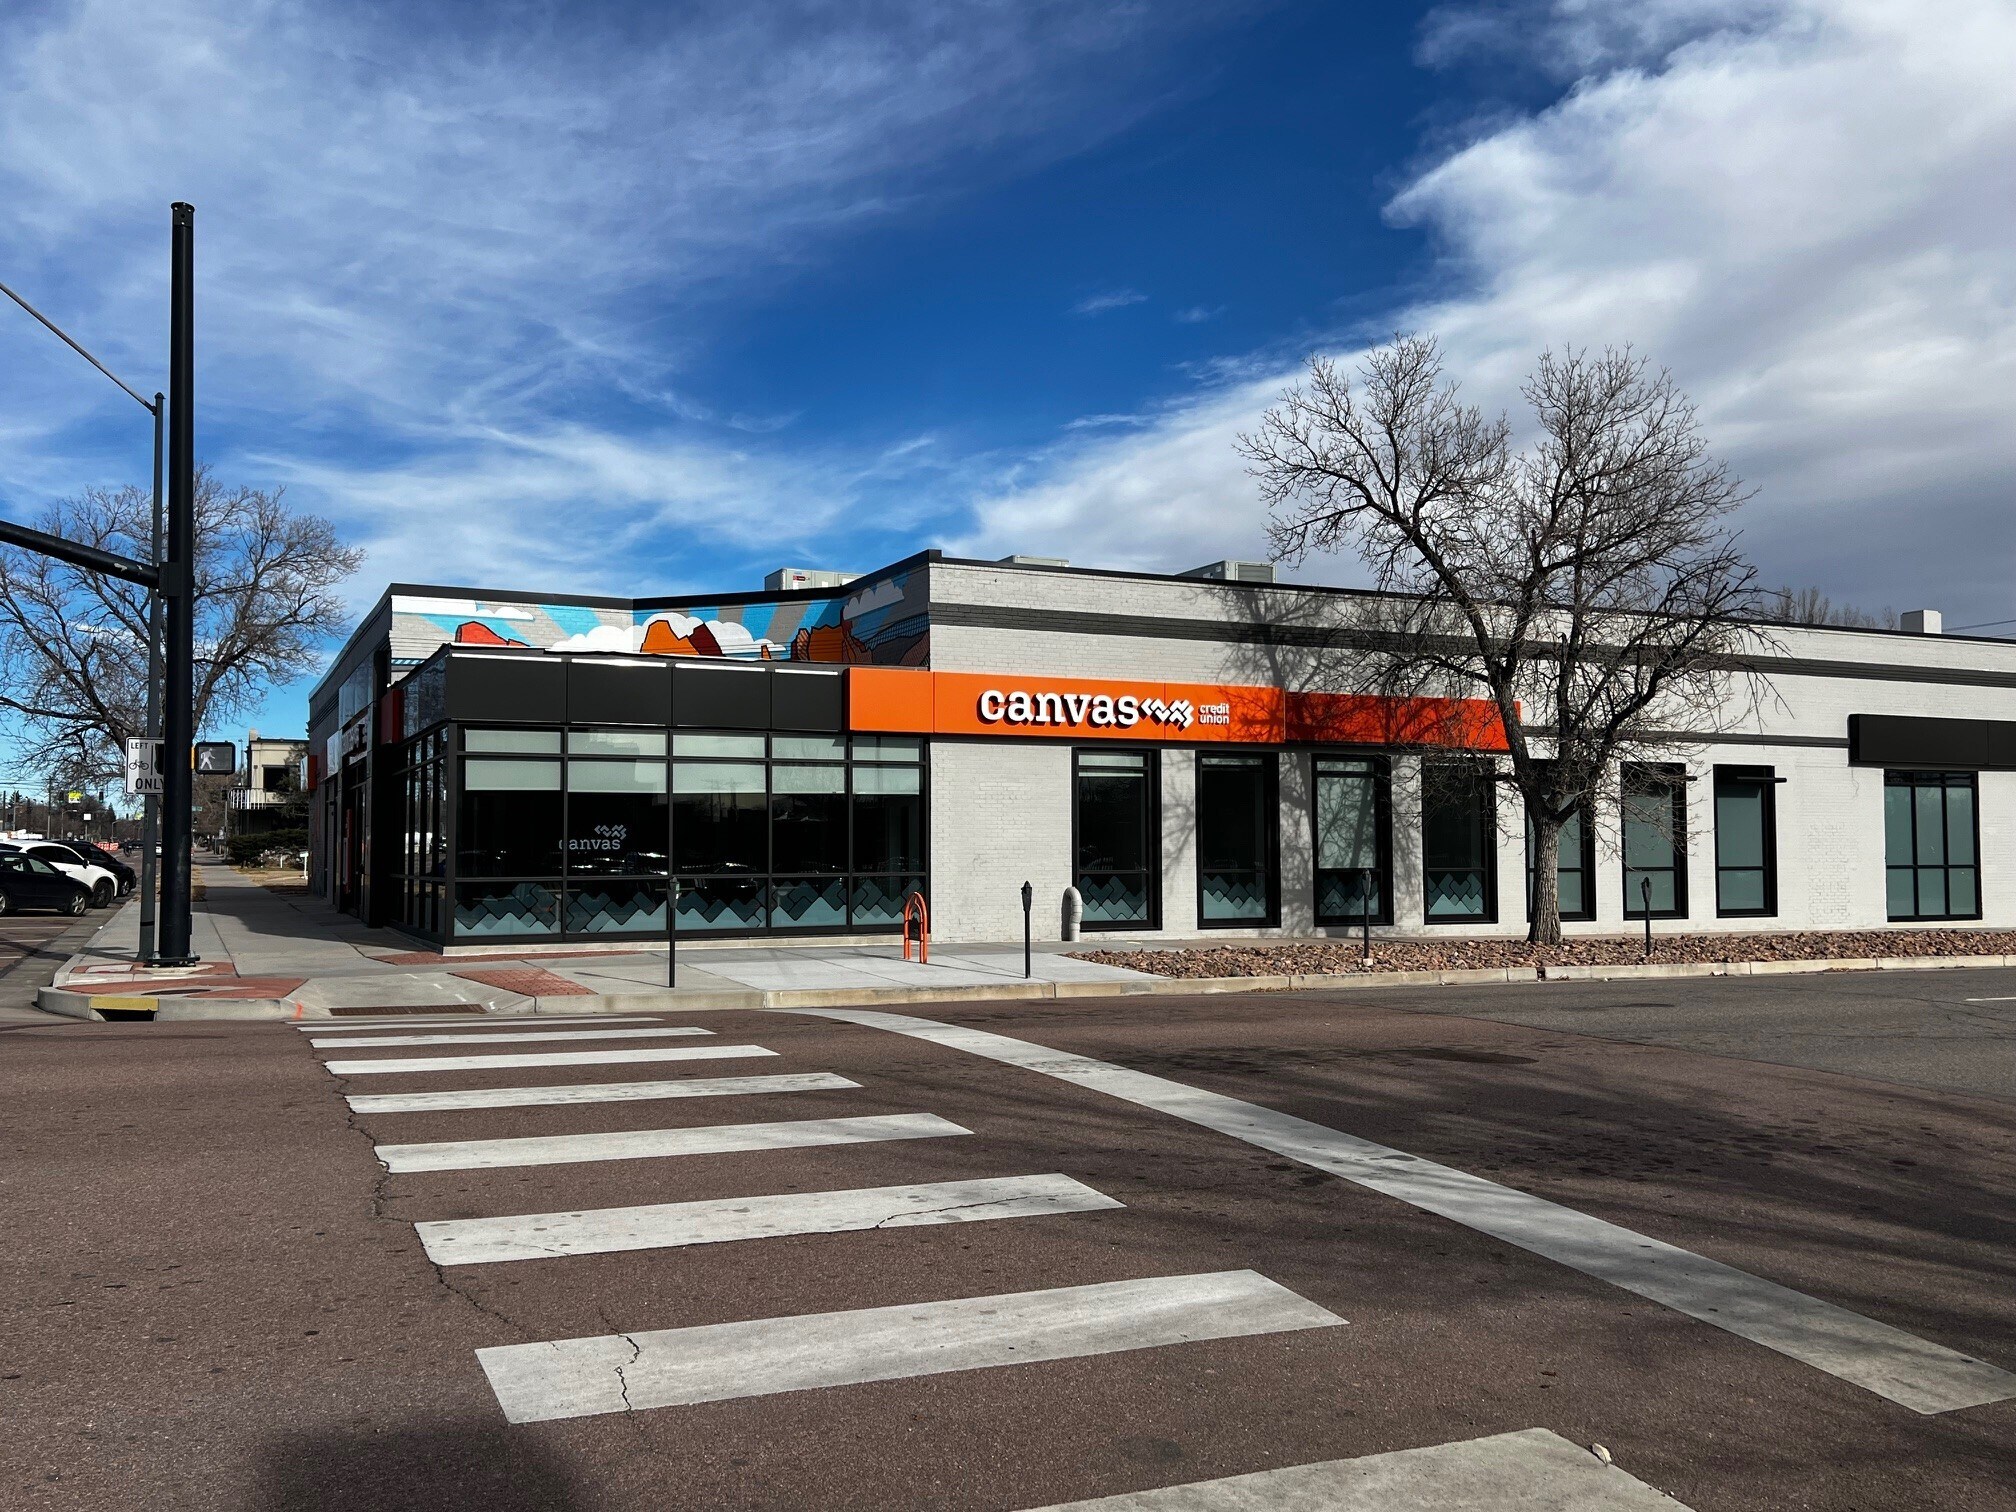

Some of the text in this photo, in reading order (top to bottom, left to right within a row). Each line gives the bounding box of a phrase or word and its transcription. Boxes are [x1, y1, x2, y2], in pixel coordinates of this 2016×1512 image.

[980, 689, 1139, 726] canvas
[1200, 702, 1230, 715] credit
[1200, 713, 1230, 725] union
[130, 742, 149, 750] LEFT
